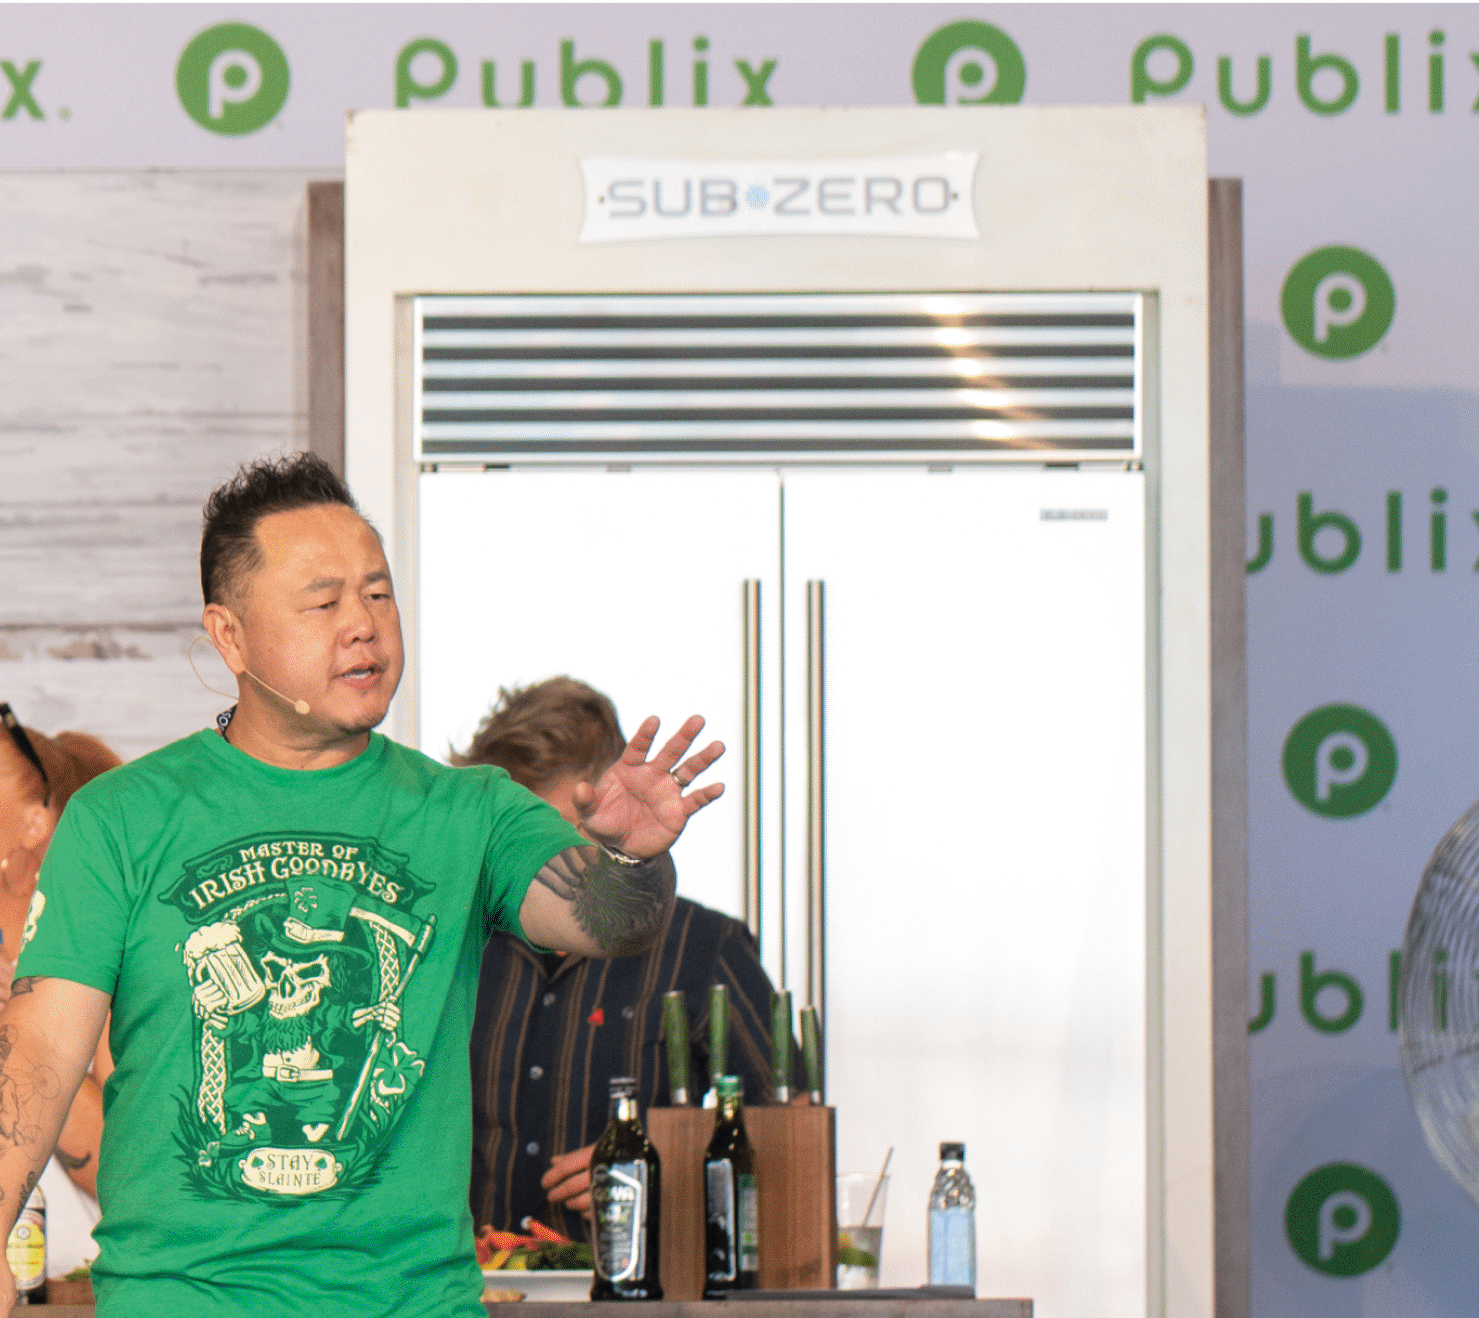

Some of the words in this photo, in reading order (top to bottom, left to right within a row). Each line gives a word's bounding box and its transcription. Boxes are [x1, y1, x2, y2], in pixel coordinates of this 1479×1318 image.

[393, 35, 778, 109] Publix
[1130, 30, 1479, 117] Publi
[607, 177, 739, 219] SUB
[773, 174, 951, 216] ZERO
[238, 840, 325, 863] MASTER
[331, 843, 360, 861] OF
[188, 860, 266, 910] IRISH
[270, 855, 405, 904] GOODBYES
[259, 1170, 321, 1187] SLAINTE
[266, 1153, 313, 1171] STAY
